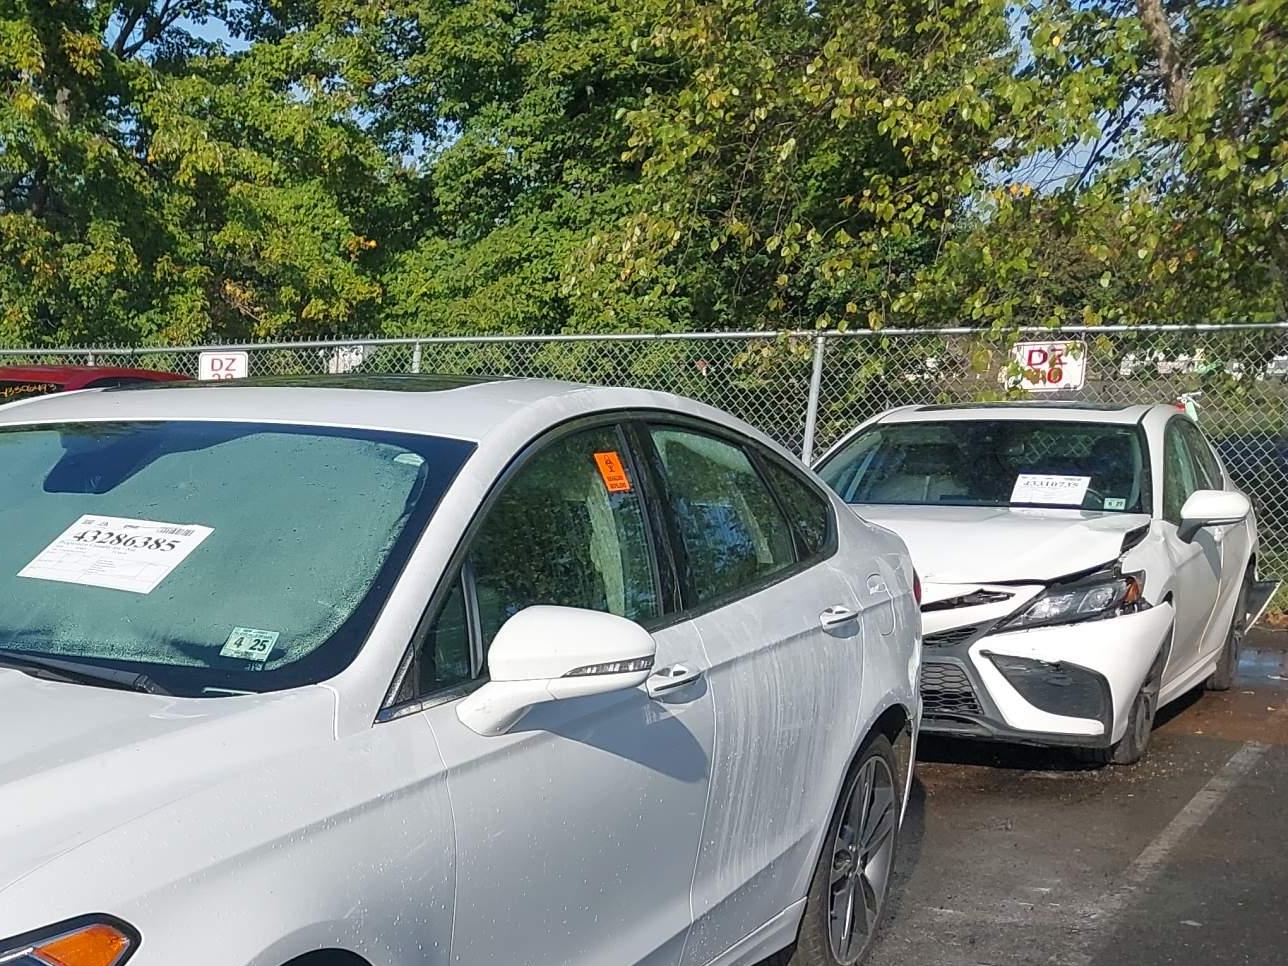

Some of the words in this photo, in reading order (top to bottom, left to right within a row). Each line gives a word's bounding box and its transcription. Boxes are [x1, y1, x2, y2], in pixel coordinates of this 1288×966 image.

[211, 358, 236, 371] DZ
[73, 529, 181, 552] 43286385
[234, 636, 245, 648] 4
[248, 638, 269, 652] 25
